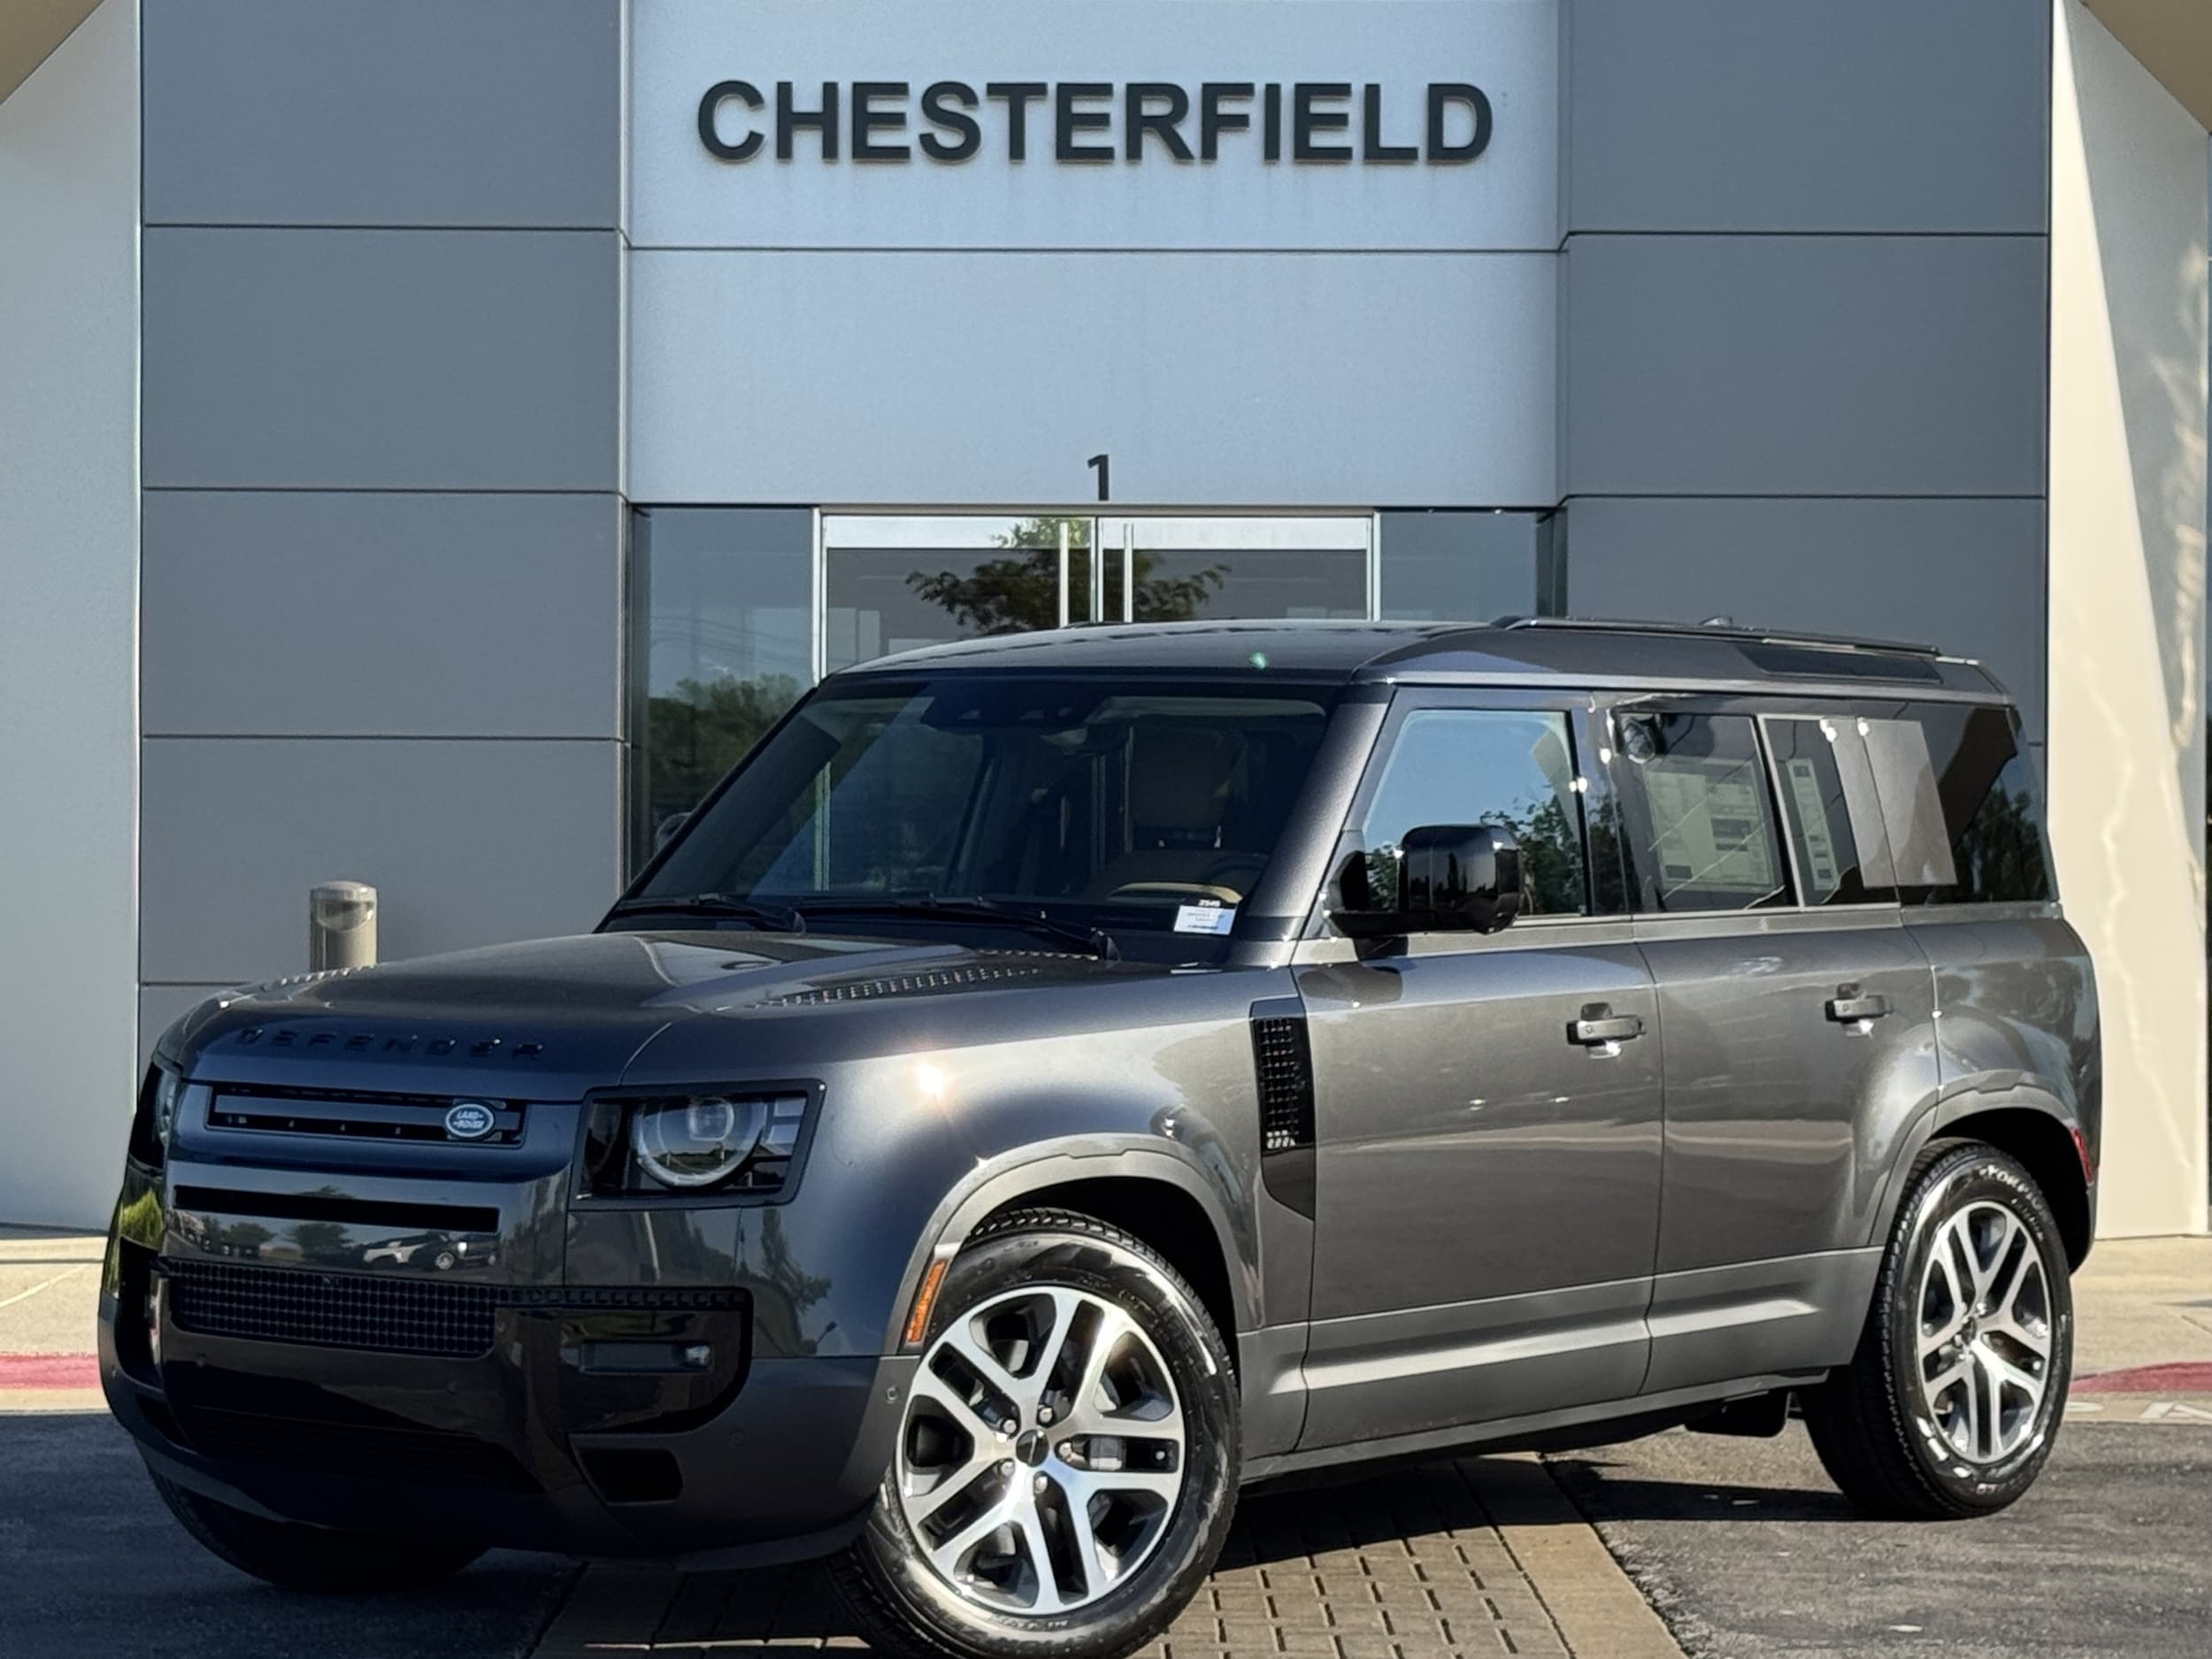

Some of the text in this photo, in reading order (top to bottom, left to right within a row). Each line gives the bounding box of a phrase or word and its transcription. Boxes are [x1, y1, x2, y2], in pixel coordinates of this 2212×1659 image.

[697, 80, 1494, 163] CHESTERFIELD
[1087, 454, 1110, 502] 1
[234, 1027, 546, 1061] DEFENDER
